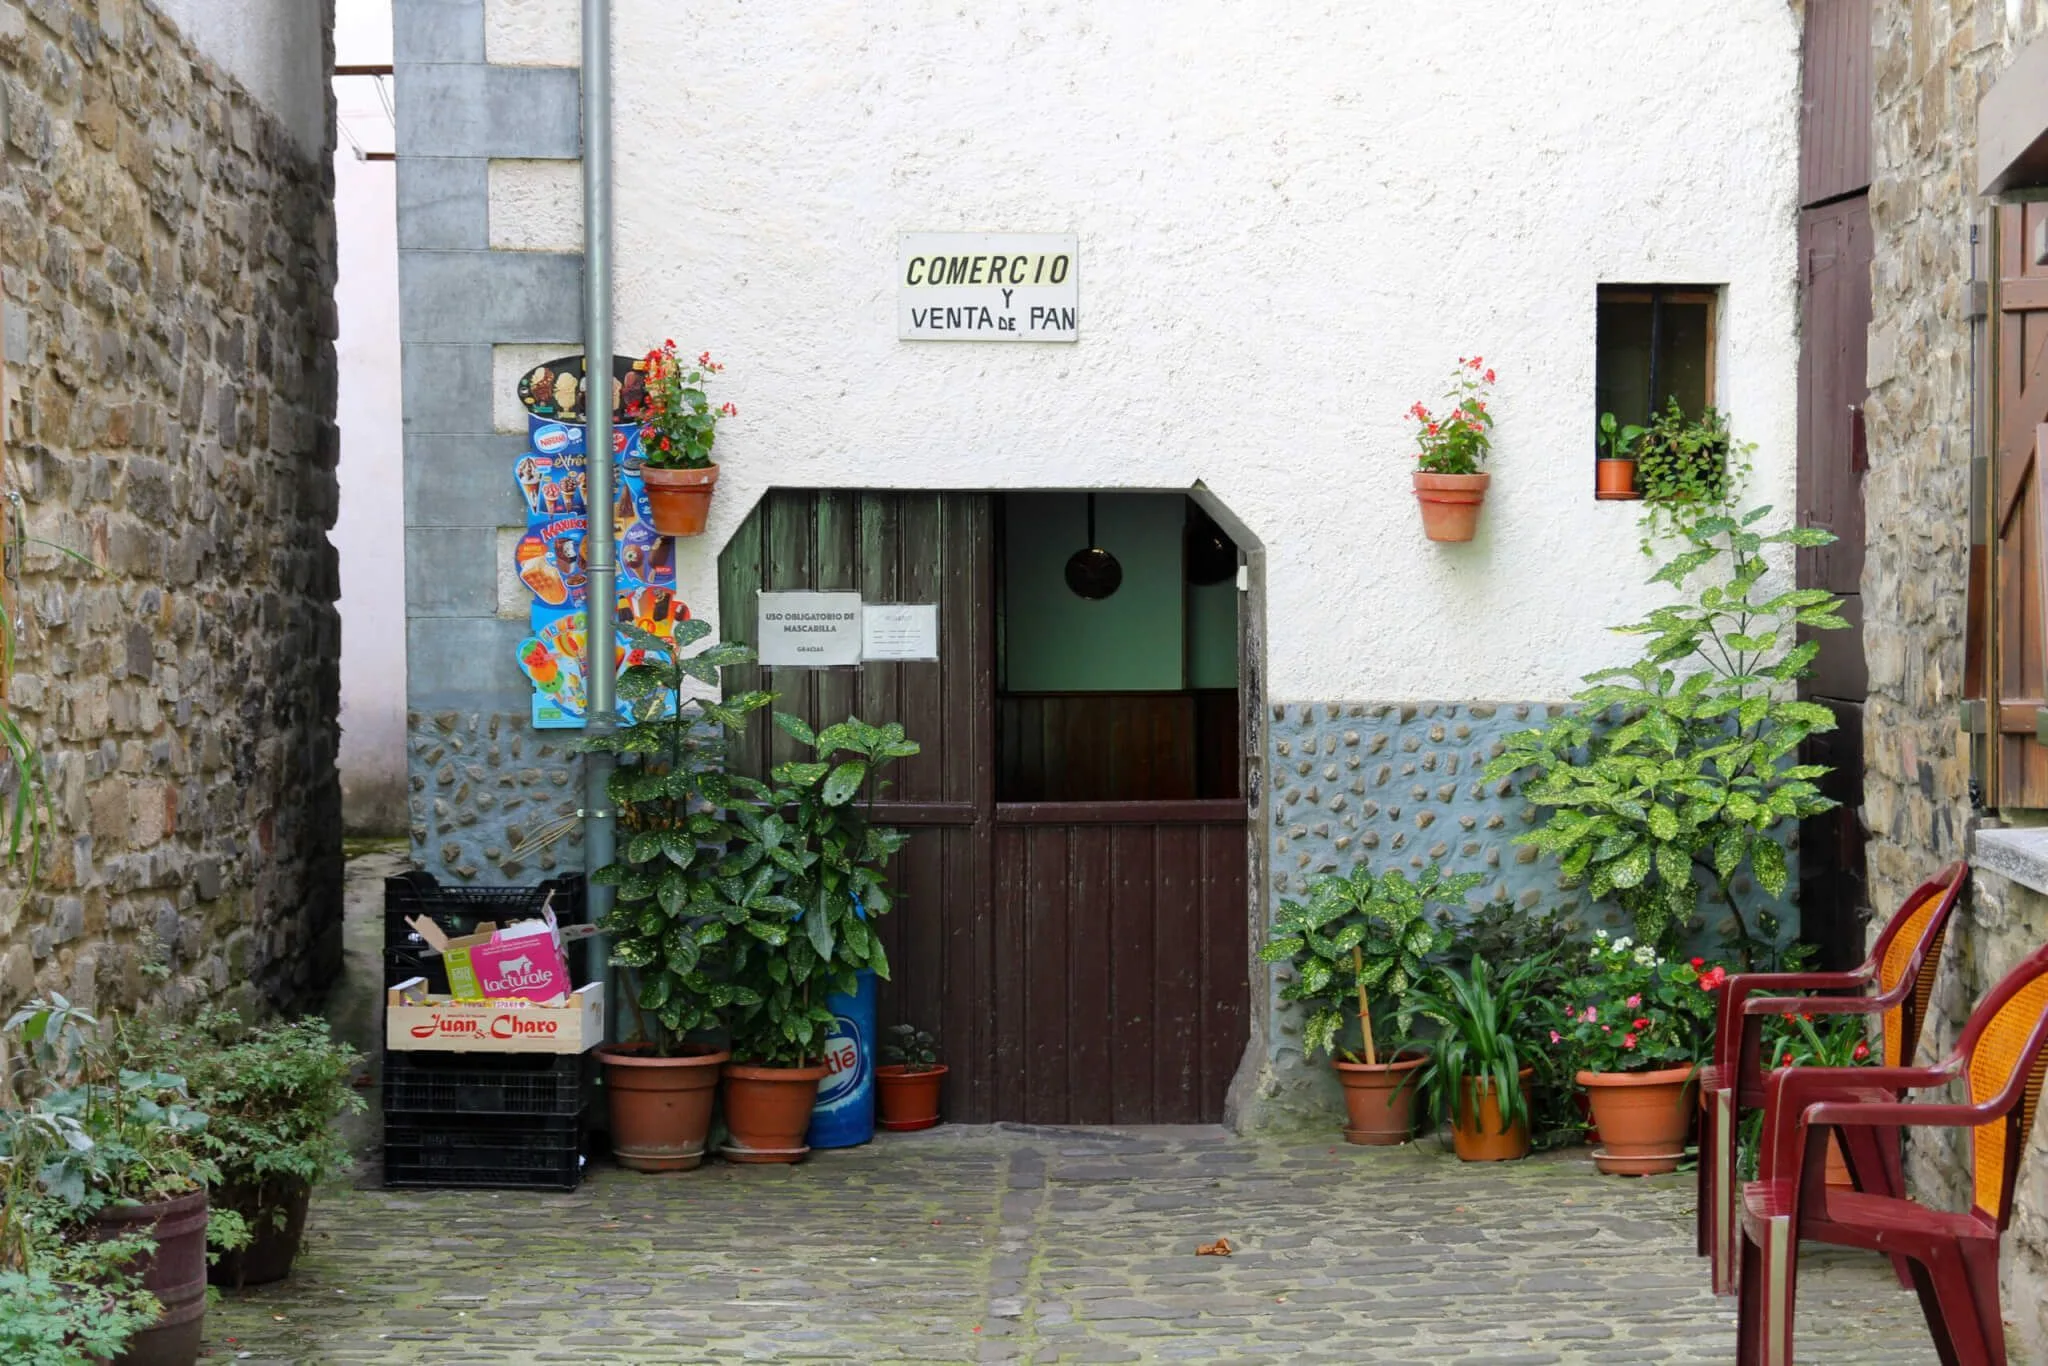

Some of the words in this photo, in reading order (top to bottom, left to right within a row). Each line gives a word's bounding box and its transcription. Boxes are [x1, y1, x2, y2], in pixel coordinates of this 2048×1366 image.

[906, 254, 1069, 285] COMERCIO
[1001, 287, 1014, 309] Y
[911, 305, 994, 330] VENTA
[998, 316, 1017, 331] DE
[1030, 306, 1076, 330] PAN
[765, 612, 783, 621] USO
[784, 612, 842, 622] OBLIGATORIO
[843, 612, 855, 621] DE
[783, 624, 837, 633] MASCARILLA
[796, 645, 824, 653] GRACIAS
[483, 969, 553, 993] lacturale
[410, 1013, 477, 1038] Juan
[490, 1014, 558, 1039] Charo
